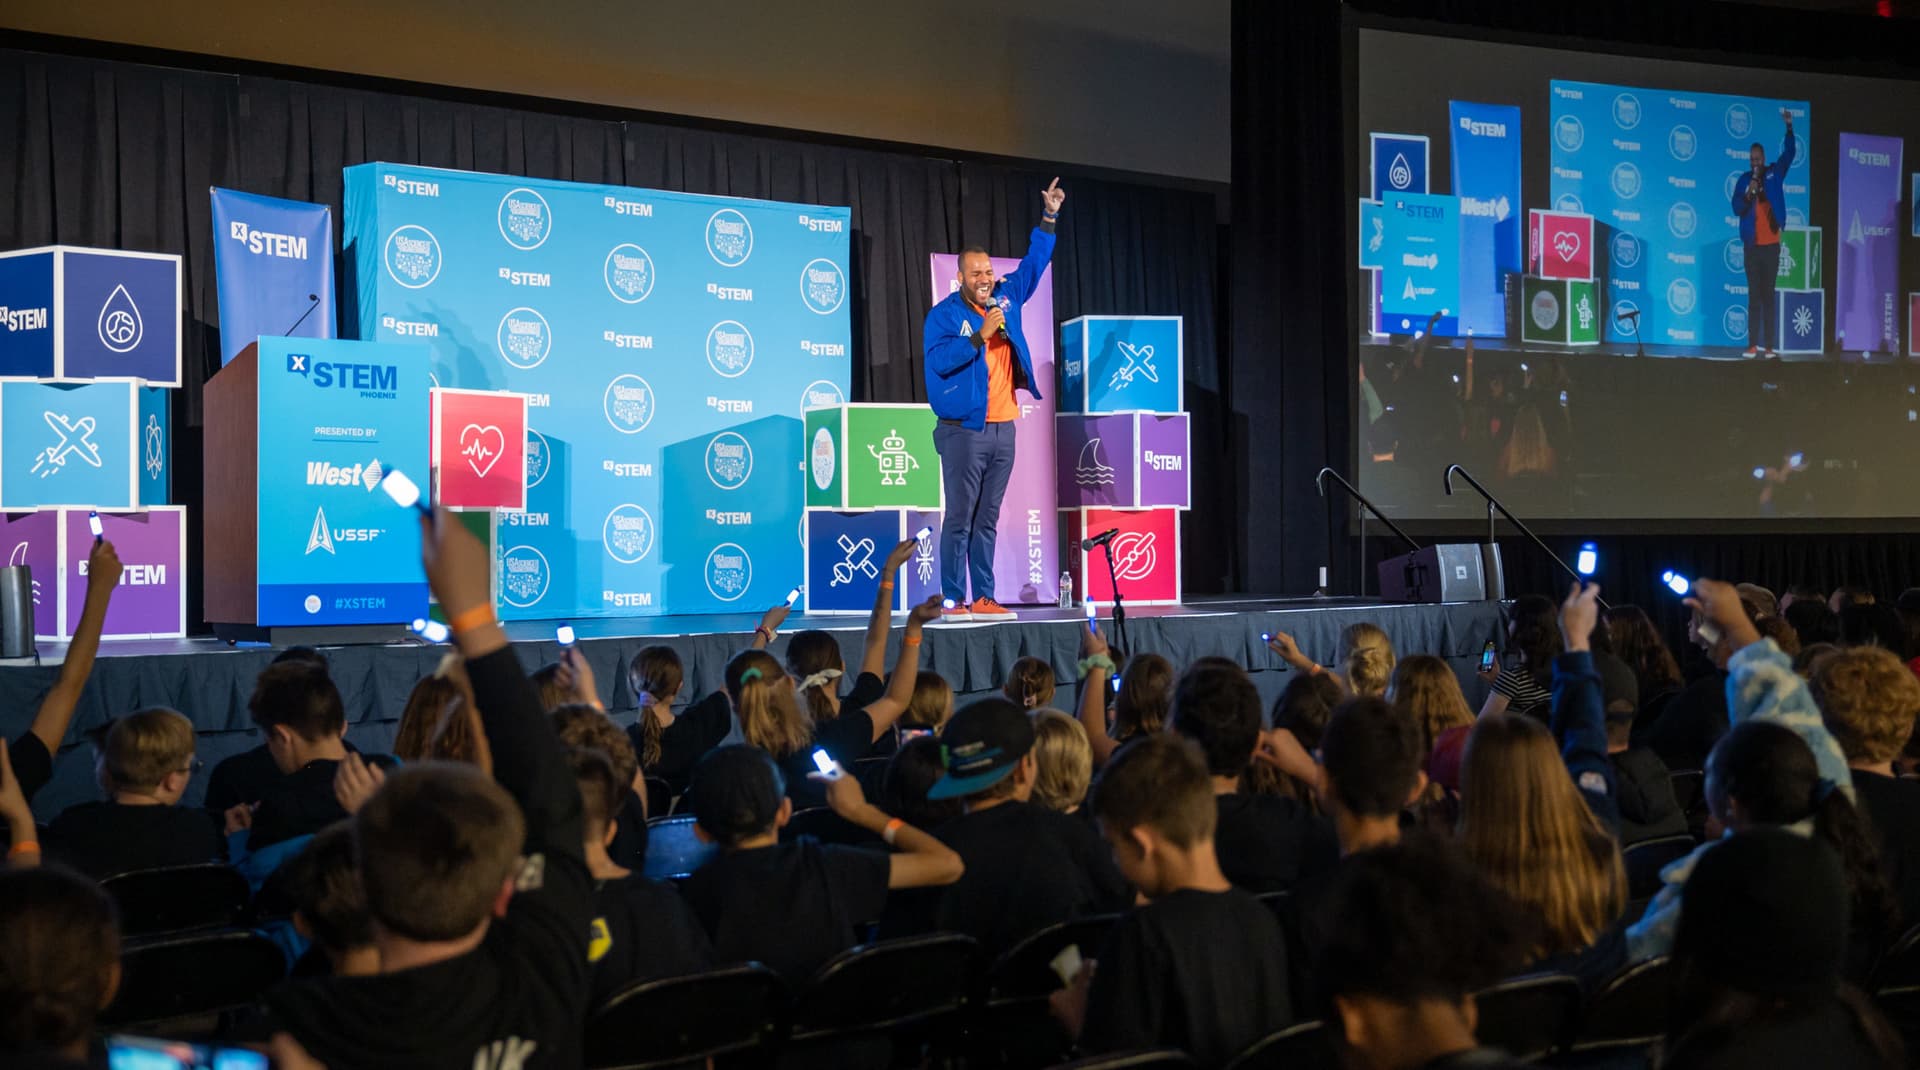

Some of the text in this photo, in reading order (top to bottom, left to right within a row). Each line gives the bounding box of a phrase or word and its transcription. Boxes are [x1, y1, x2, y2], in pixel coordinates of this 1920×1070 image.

[360, 391, 397, 400] PHOENIX
[314, 426, 377, 437] PRESENTED BY
[306, 461, 364, 486] West
[1028, 509, 1042, 584] #XSTEM
[335, 598, 385, 609] #XSTEM
